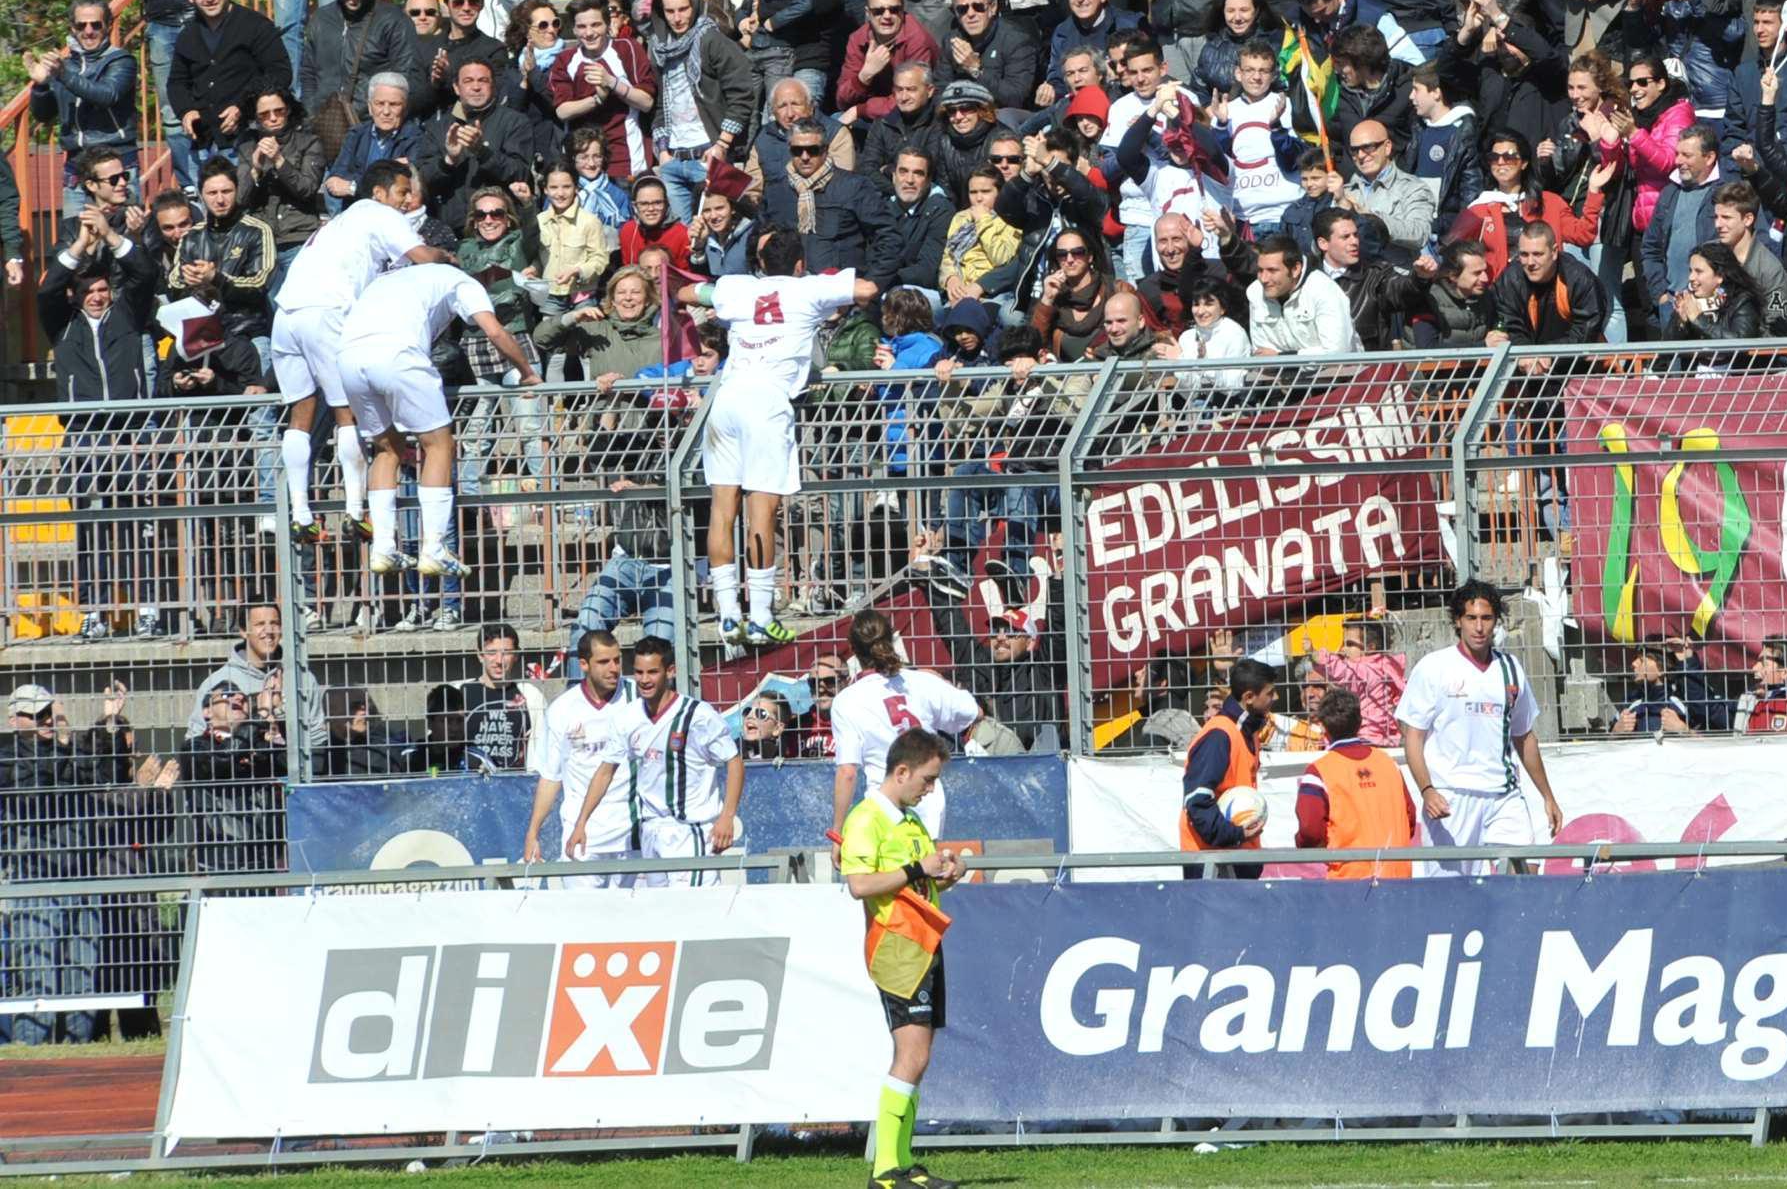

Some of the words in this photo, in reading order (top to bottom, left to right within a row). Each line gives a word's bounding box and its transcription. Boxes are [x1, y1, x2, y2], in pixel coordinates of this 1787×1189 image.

[1102, 495, 1406, 653] GRANATA
[1600, 422, 1751, 644] 19
[474, 733, 514, 745] SUPER
[479, 721, 514, 733] HAVE
[488, 710, 508, 721] WE
[883, 695, 923, 735] 5
[320, 951, 769, 1080] dixe
[1040, 929, 1483, 1056] Grandi
